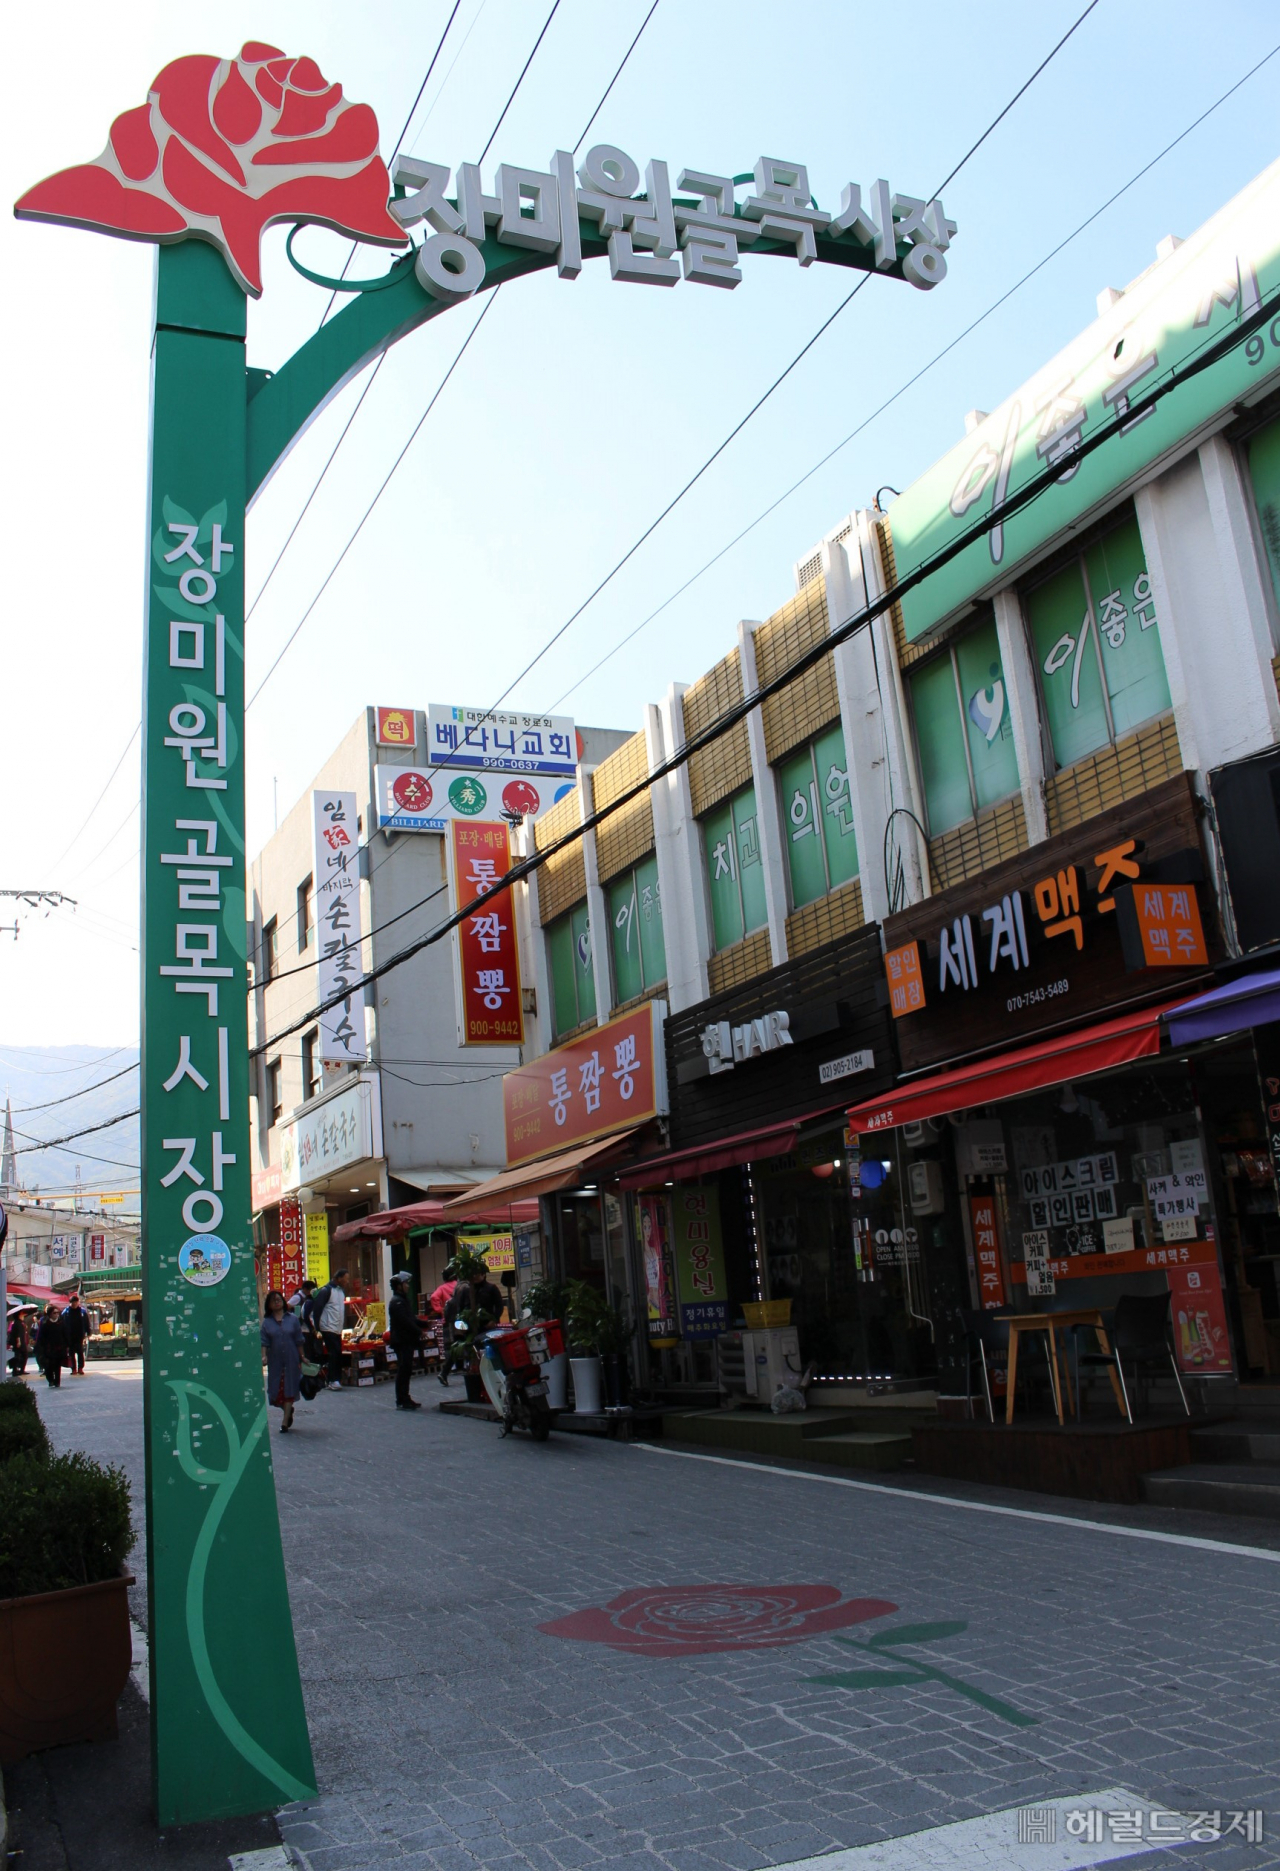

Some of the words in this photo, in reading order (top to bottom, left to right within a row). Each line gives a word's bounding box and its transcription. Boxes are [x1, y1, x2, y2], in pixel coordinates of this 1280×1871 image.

[466, 711, 518, 725] 대한예수교
[521, 716, 553, 729] 장로회
[436, 723, 571, 759] 베다니교회
[482, 757, 540, 770] 990-0637
[404, 783, 421, 801] 수
[460, 788, 477, 805] 秀
[390, 818, 446, 829] BILLIARD
[323, 877, 353, 891] 바지락
[1144, 890, 1191, 921] 세계
[939, 839, 1140, 993] 세계맥주
[1149, 928, 1198, 959] 맥주
[888, 951, 916, 978] 할인
[892, 982, 921, 1011] 매장
[1007, 979, 1069, 1012] 070-7543-5489
[470, 1020, 519, 1035] 900-9442
[547, 1034, 641, 1126] 통짬뽕
[866, 1110, 894, 1129] 세계맥주
[513, 1118, 541, 1142] 900-9442
[1024, 1155, 1115, 1194] 아이스크림
[1172, 1175, 1180, 1188] &
[1185, 1173, 1205, 1187] 와인
[1032, 1188, 1114, 1226] 할인판매
[1157, 1197, 1195, 1216] 특가행사
[684, 1192, 716, 1297] 현미용실
[1024, 1233, 1047, 1246] 아이스
[1081, 1234, 1093, 1246] ICE
[1029, 1245, 1044, 1257] 커피
[1146, 1247, 1190, 1265] 세계맥주
[1038, 1271, 1053, 1283] 얼음
[686, 1305, 725, 1321] 정기휴일
